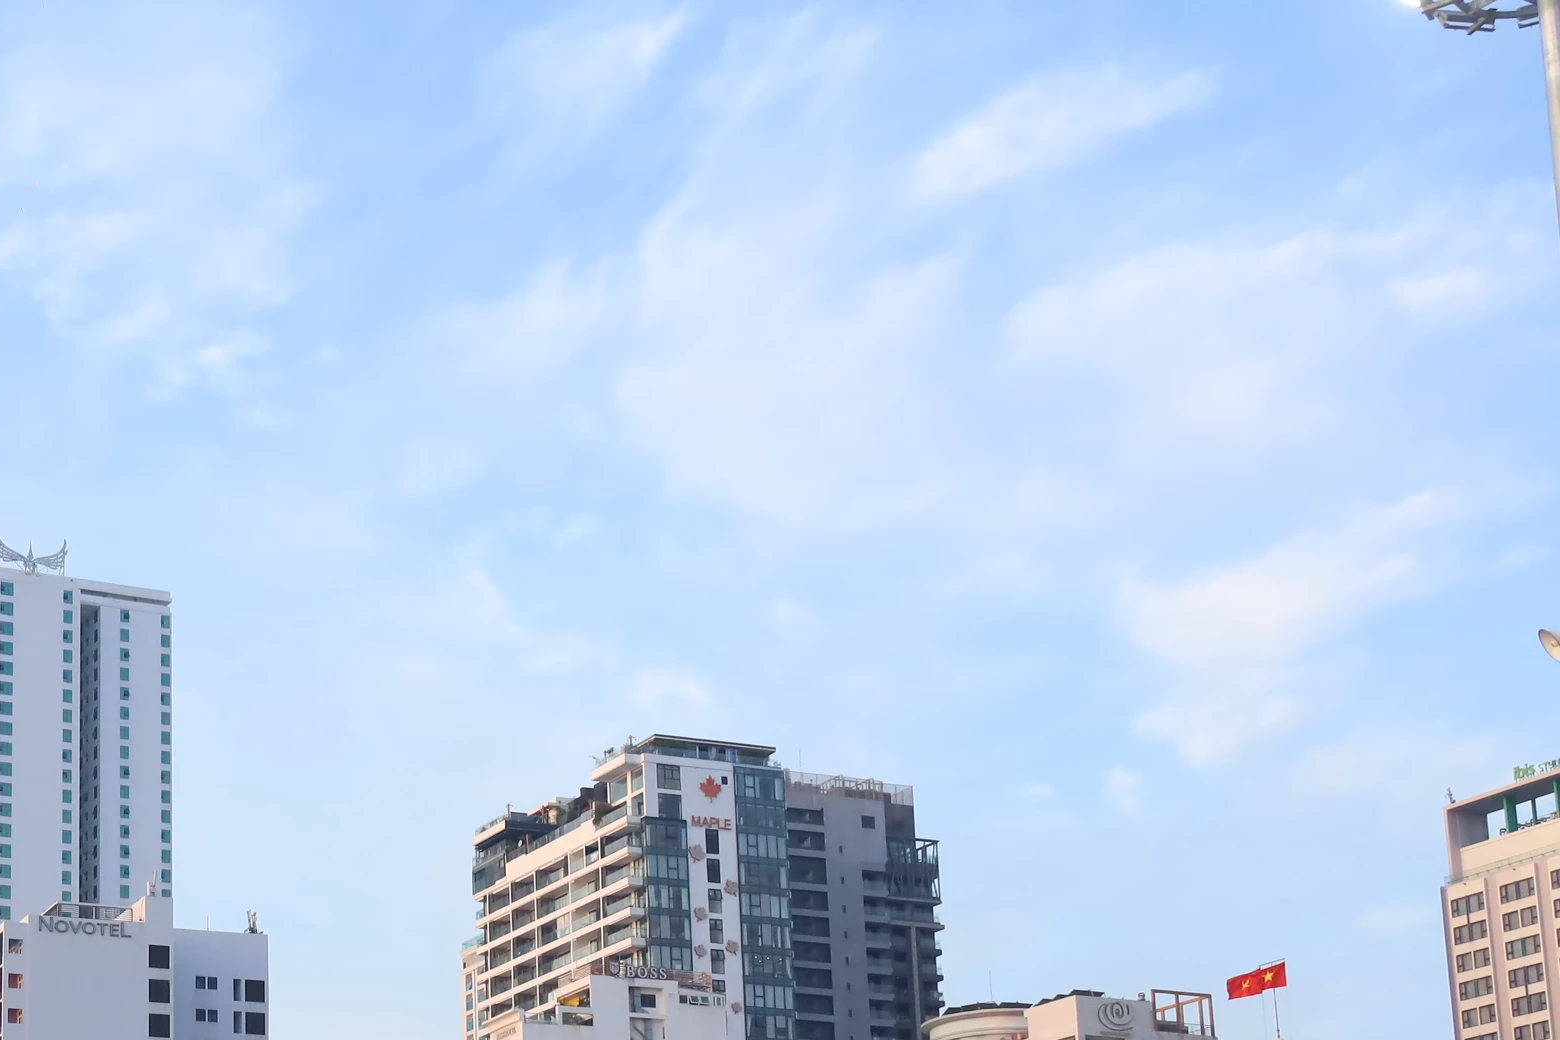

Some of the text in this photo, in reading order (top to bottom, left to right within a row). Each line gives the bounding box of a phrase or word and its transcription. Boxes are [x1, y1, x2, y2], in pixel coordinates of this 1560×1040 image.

[691, 815, 732, 831] MAPLE
[38, 916, 132, 938] NOVOTEL
[626, 966, 667, 980] BOSS
